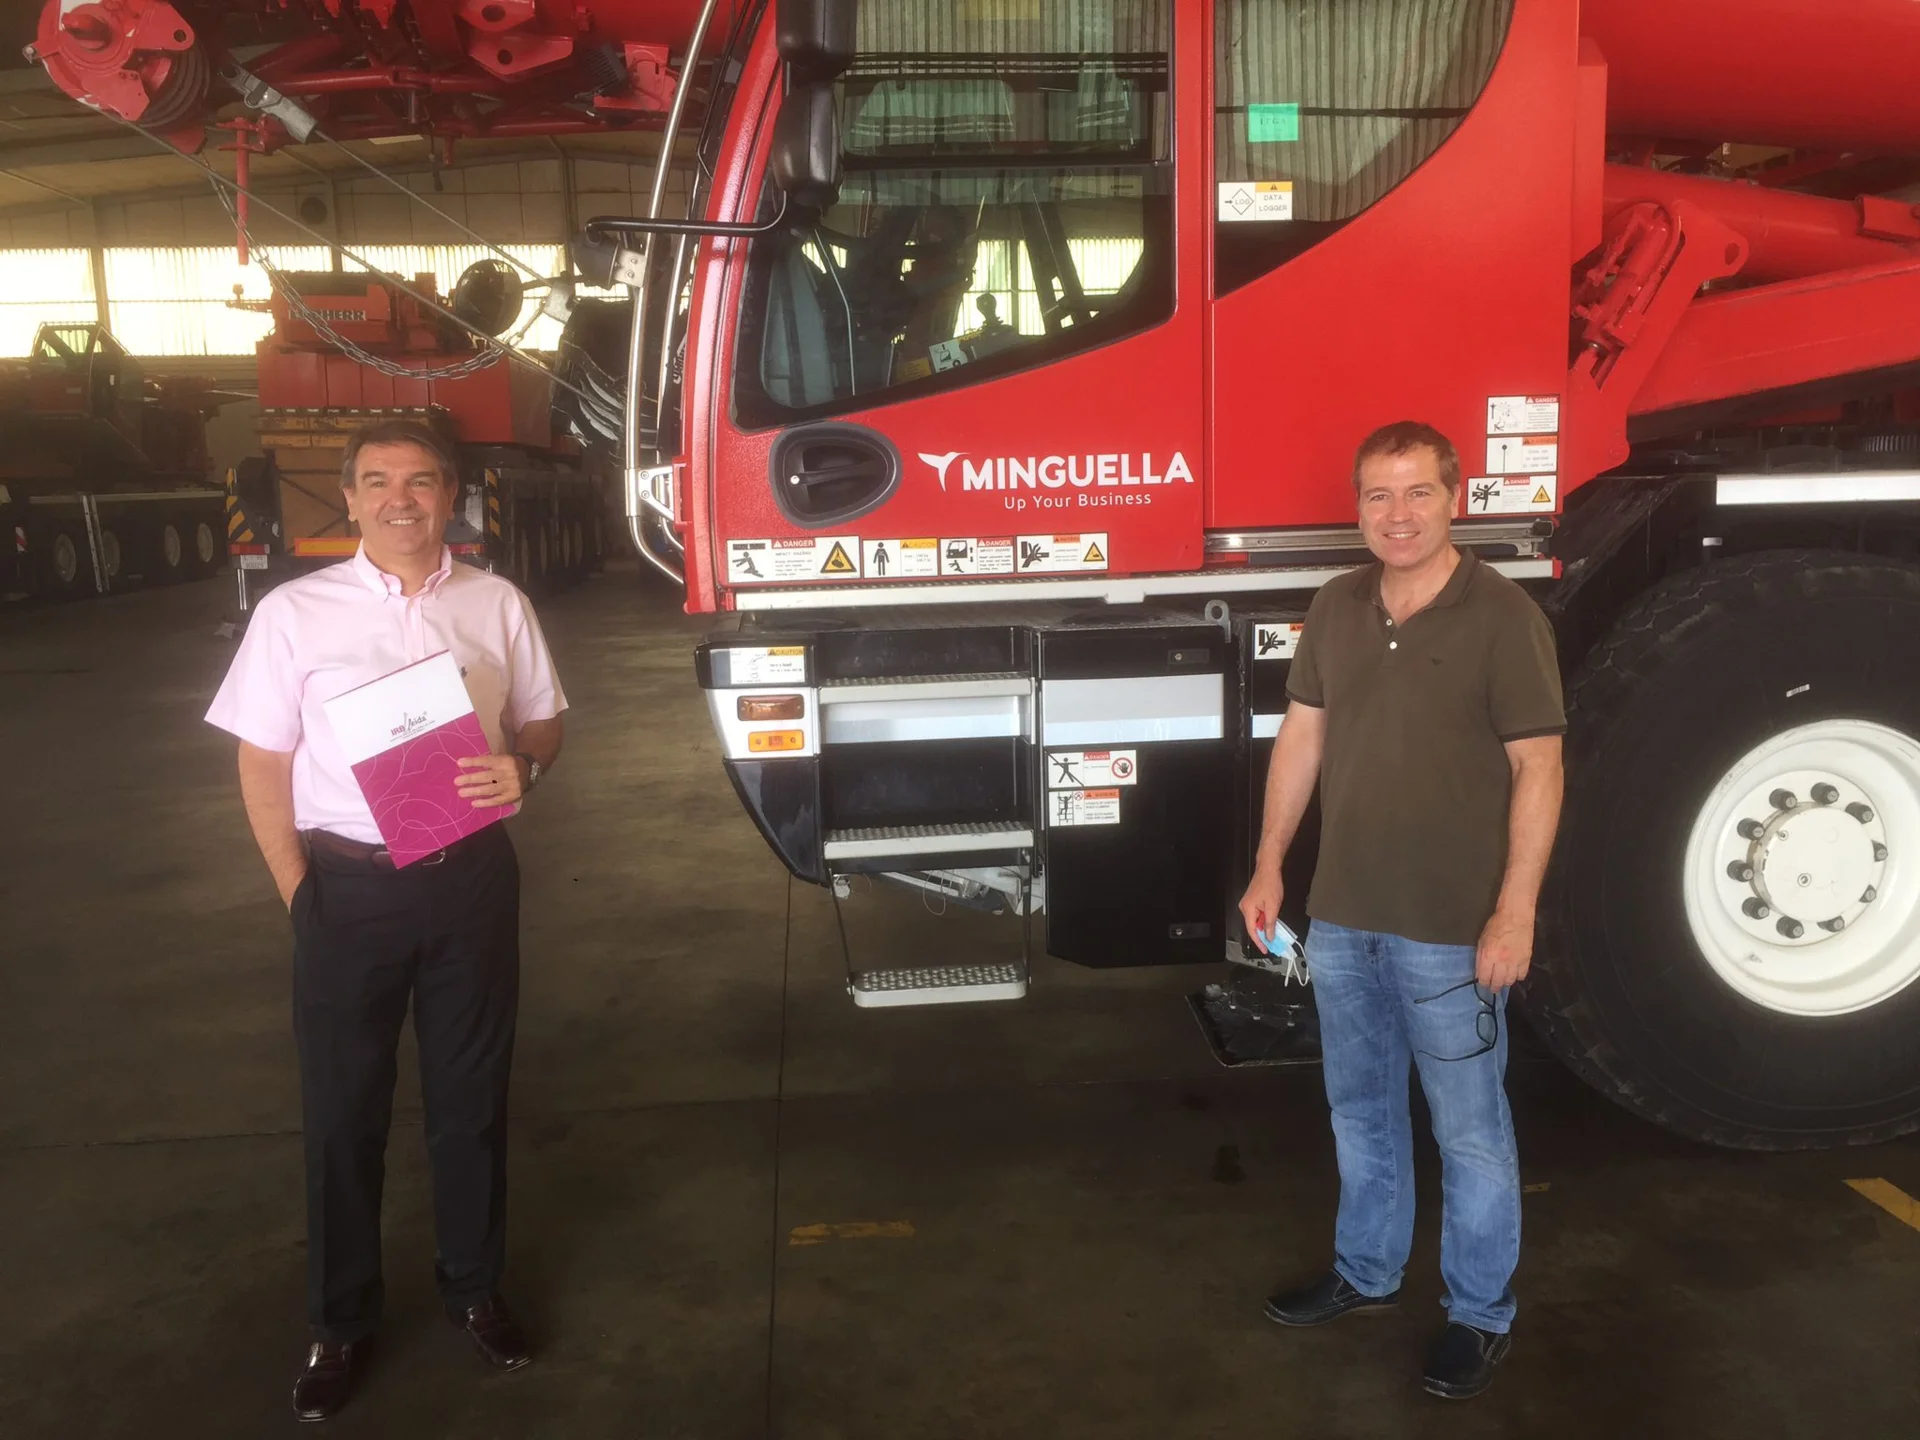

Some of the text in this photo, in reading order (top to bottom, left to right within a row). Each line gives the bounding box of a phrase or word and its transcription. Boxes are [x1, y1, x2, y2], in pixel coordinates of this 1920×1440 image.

[1258, 204, 1288, 212] LOGGER
[962, 451, 1194, 491] MINGUELLA
[1004, 492, 1152, 511] Up Your Business
[783, 539, 814, 547] DANGER
[908, 540, 936, 548] CAUTION
